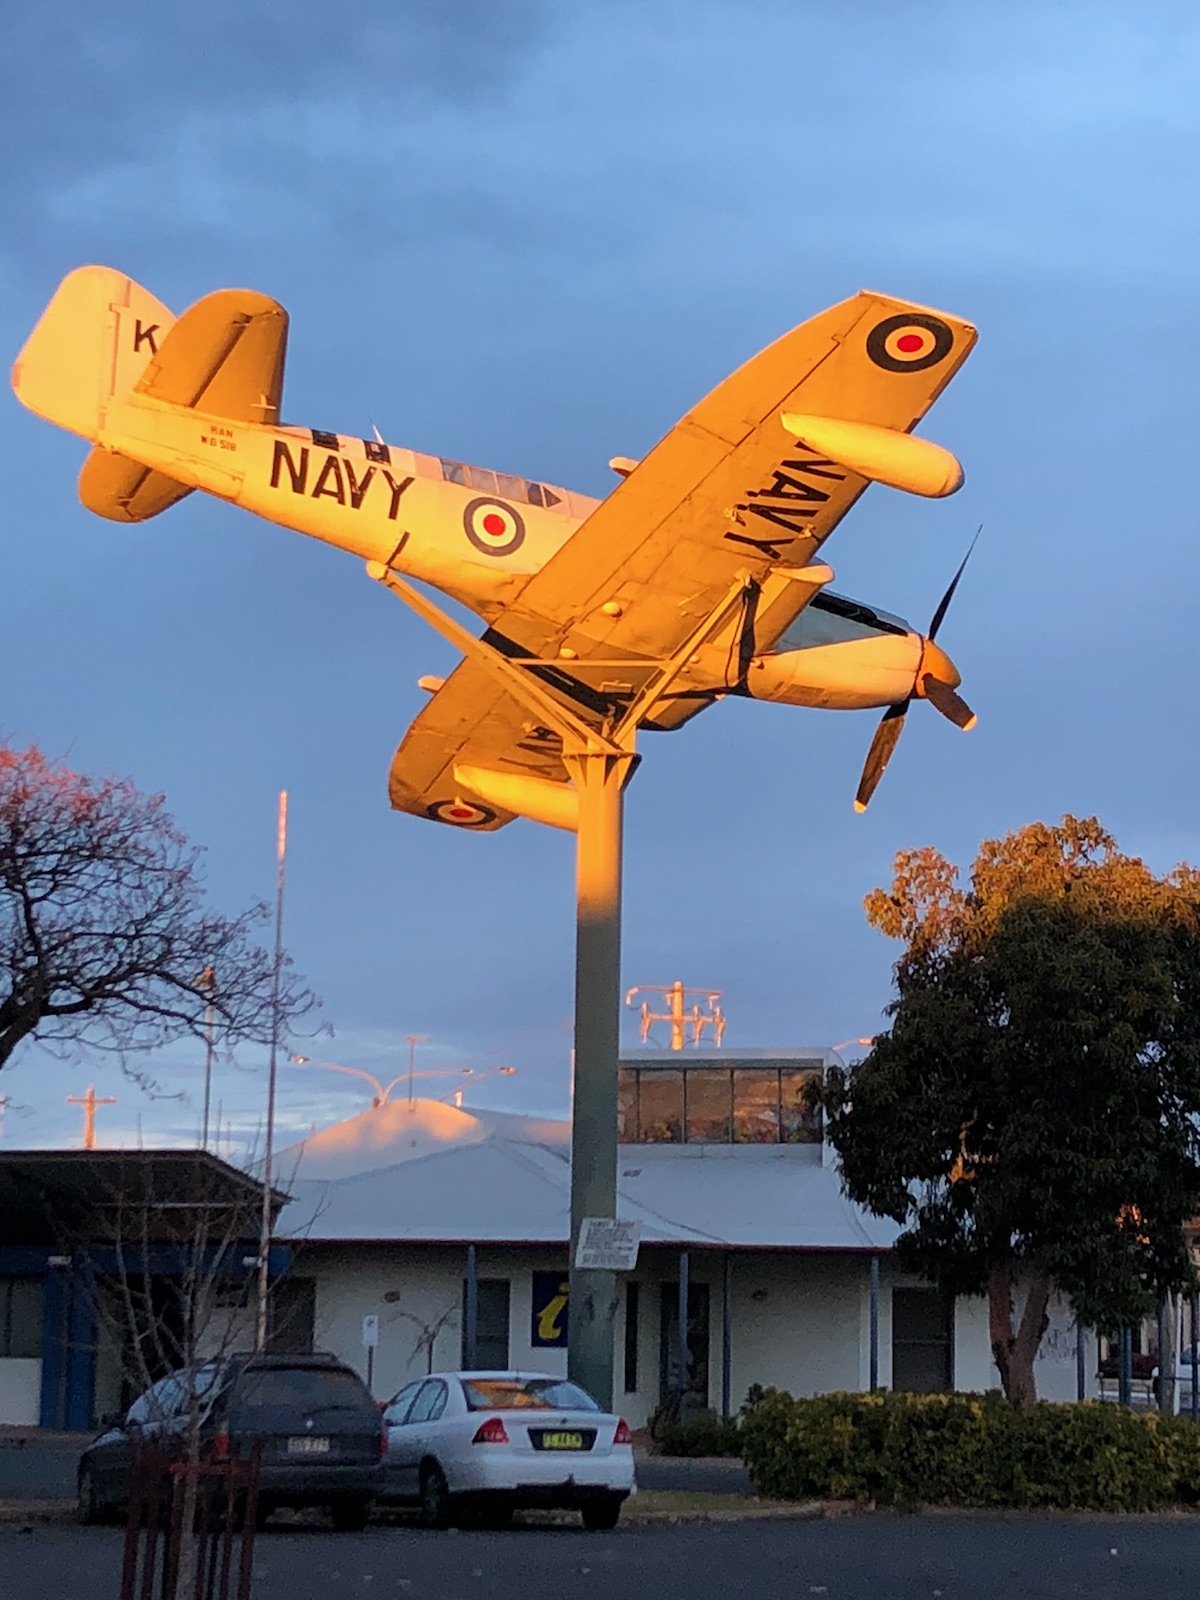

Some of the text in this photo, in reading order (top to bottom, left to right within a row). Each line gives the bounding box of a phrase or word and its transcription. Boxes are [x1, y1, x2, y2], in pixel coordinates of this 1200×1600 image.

[133, 319, 160, 356] K
[210, 425, 233, 438] RAN
[270, 440, 415, 521] NAVY
